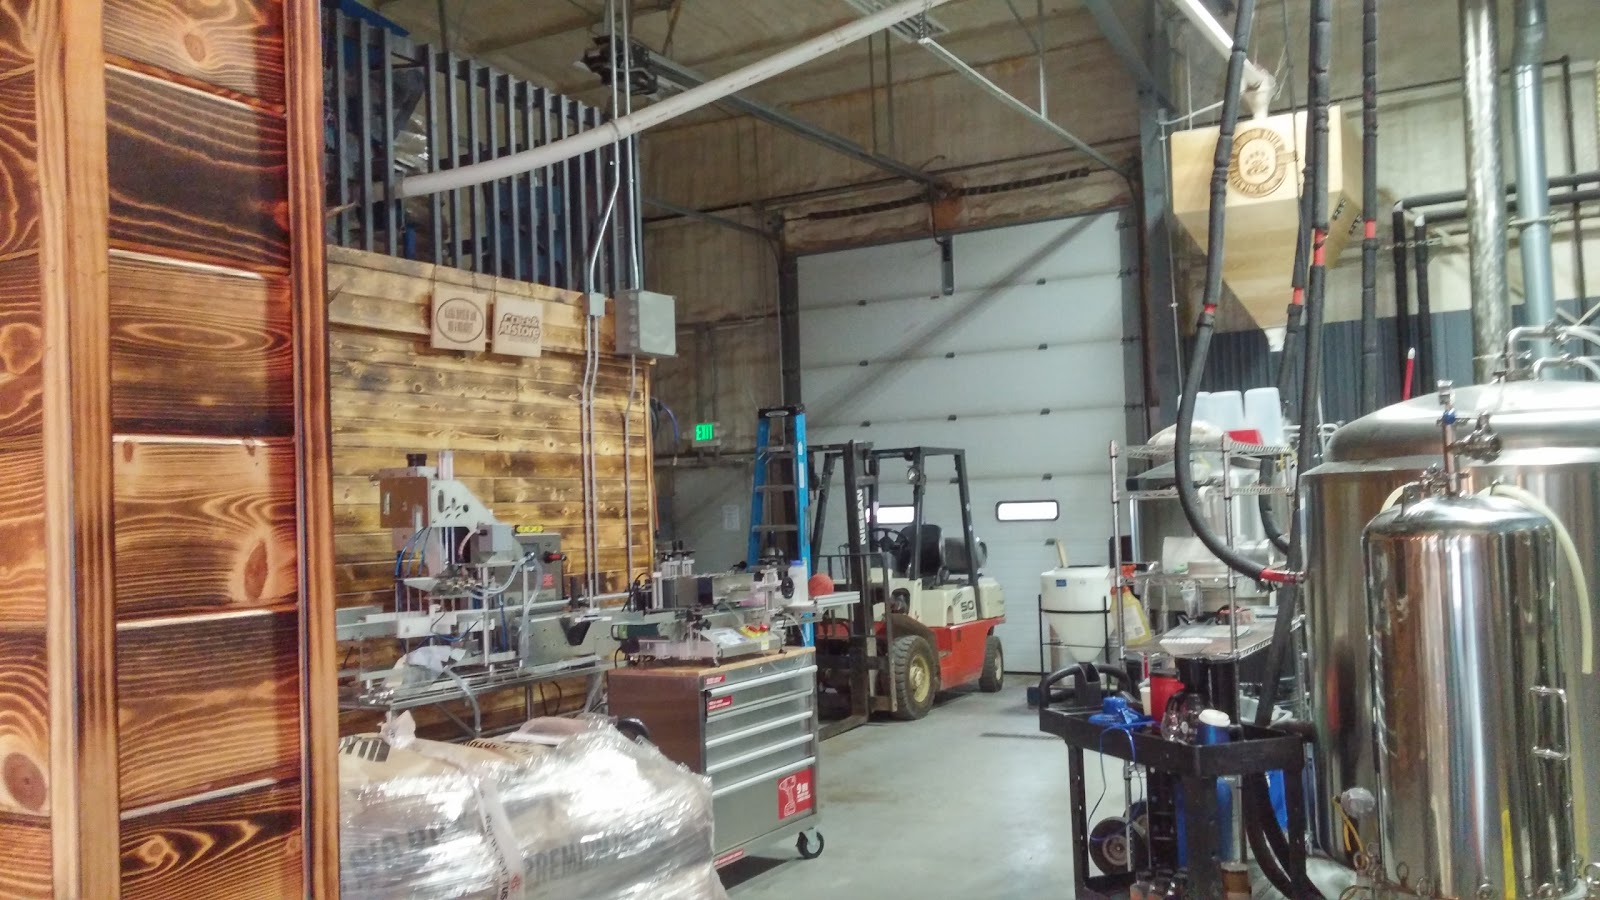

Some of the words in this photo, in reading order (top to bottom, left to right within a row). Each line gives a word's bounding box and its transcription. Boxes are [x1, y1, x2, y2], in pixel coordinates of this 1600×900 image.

[695, 424, 713, 441] EXIT
[856, 488, 868, 546] NISSAN
[960, 600, 975, 613] 50
